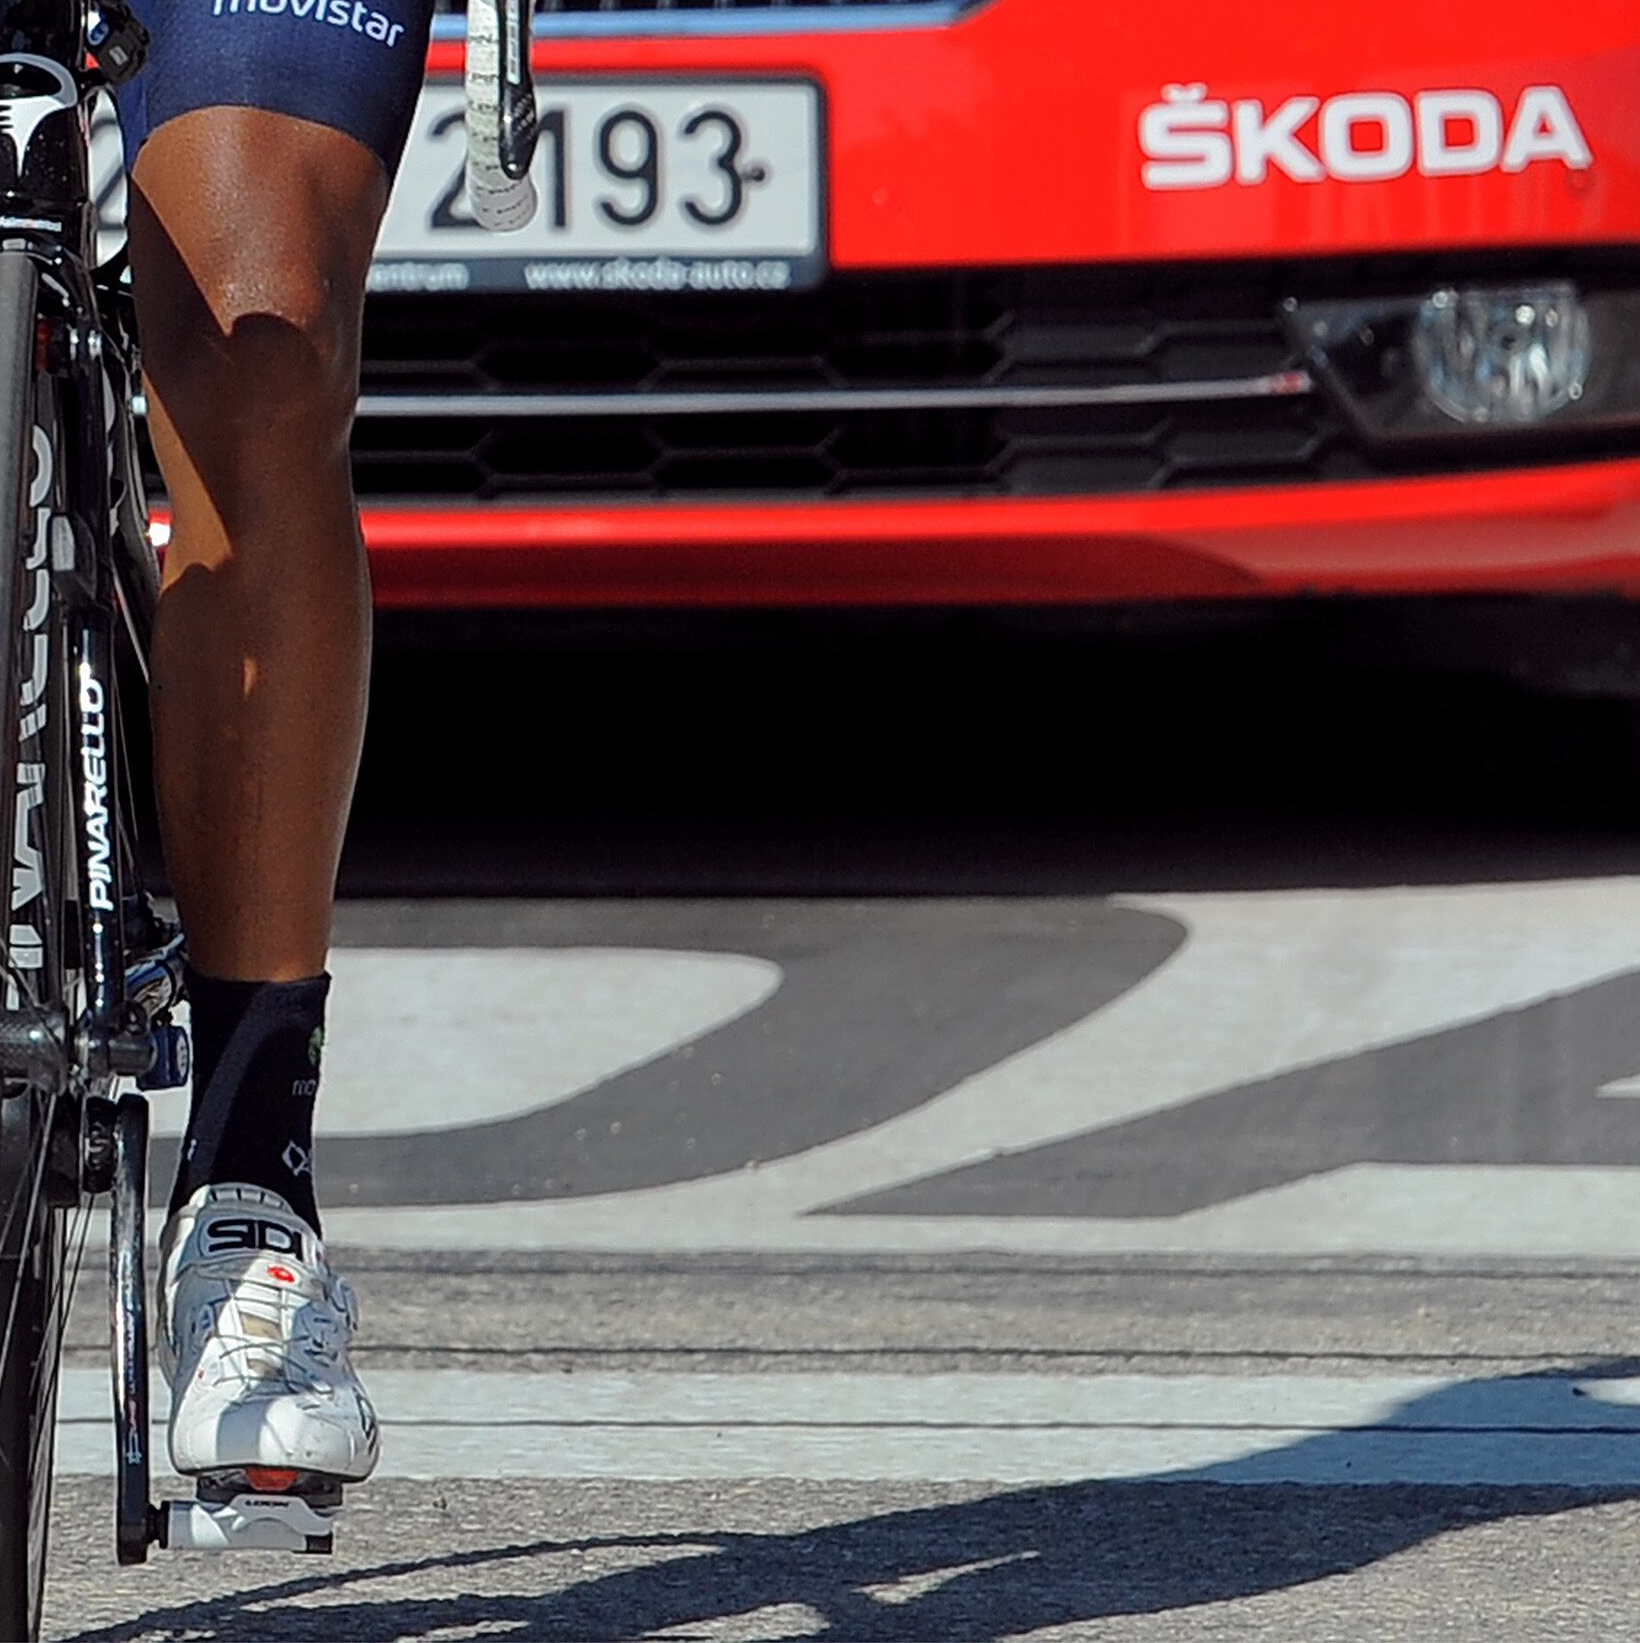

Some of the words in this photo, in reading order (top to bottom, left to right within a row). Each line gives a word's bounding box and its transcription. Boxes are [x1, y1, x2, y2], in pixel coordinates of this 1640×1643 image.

[430, 109, 744, 229] 2193
[1139, 82, 1593, 190] ŠKODA
[82, 677, 113, 912] PINARELLO
[206, 1218, 303, 1261] SIDI
